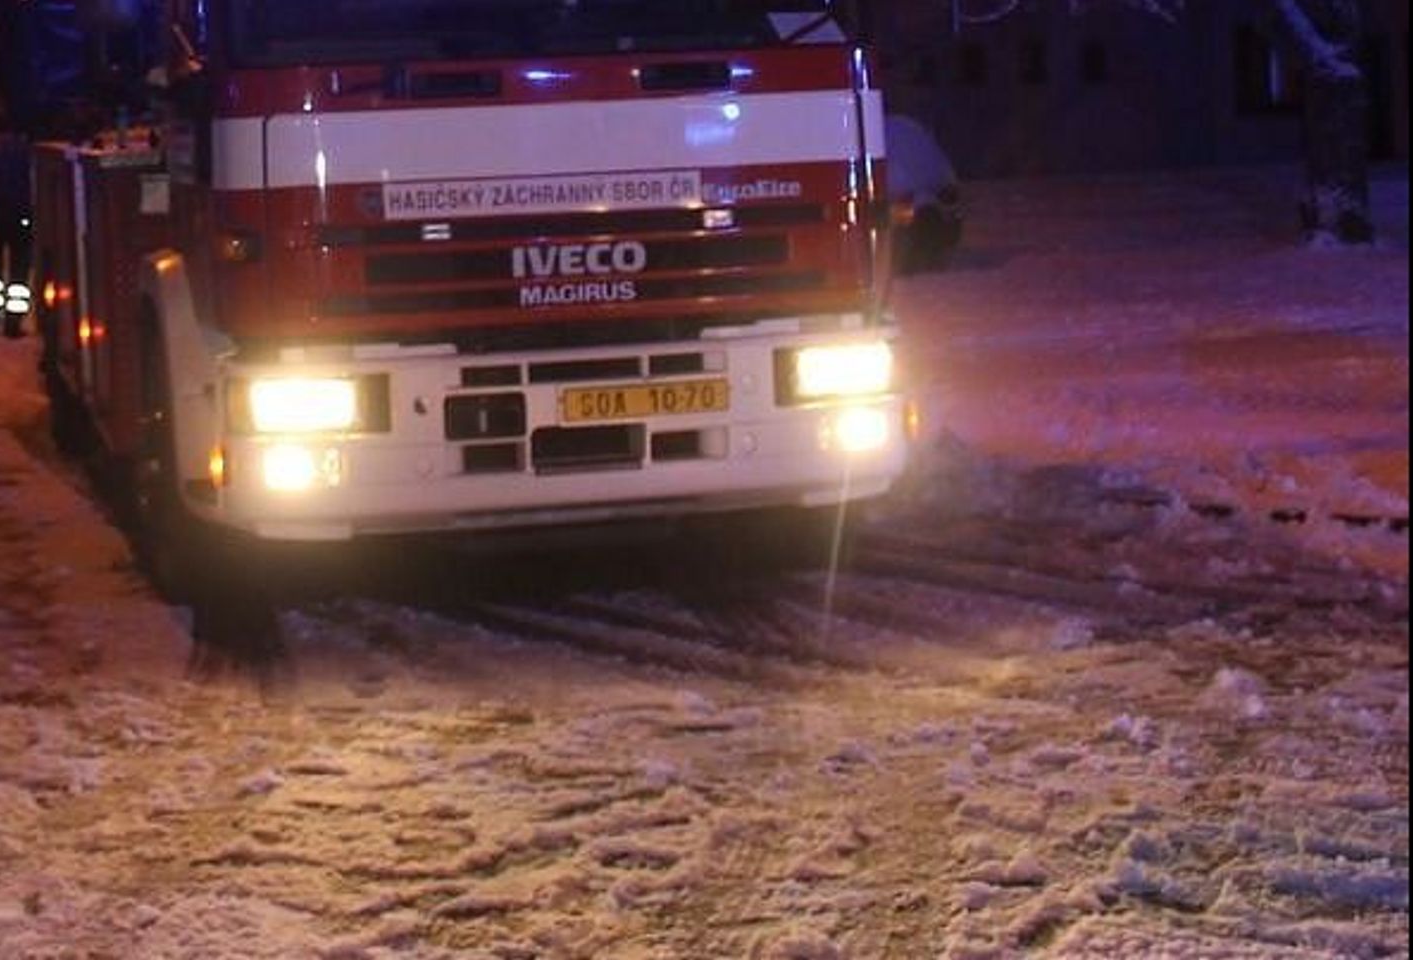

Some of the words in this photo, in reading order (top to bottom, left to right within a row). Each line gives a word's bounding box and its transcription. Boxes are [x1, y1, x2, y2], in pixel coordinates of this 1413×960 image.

[612, 181, 664, 202] SBOR
[670, 175, 695, 200] ČR
[512, 241, 646, 278] IVECO
[520, 280, 637, 307] MAGIRUS
[581, 392, 627, 417] SOA
